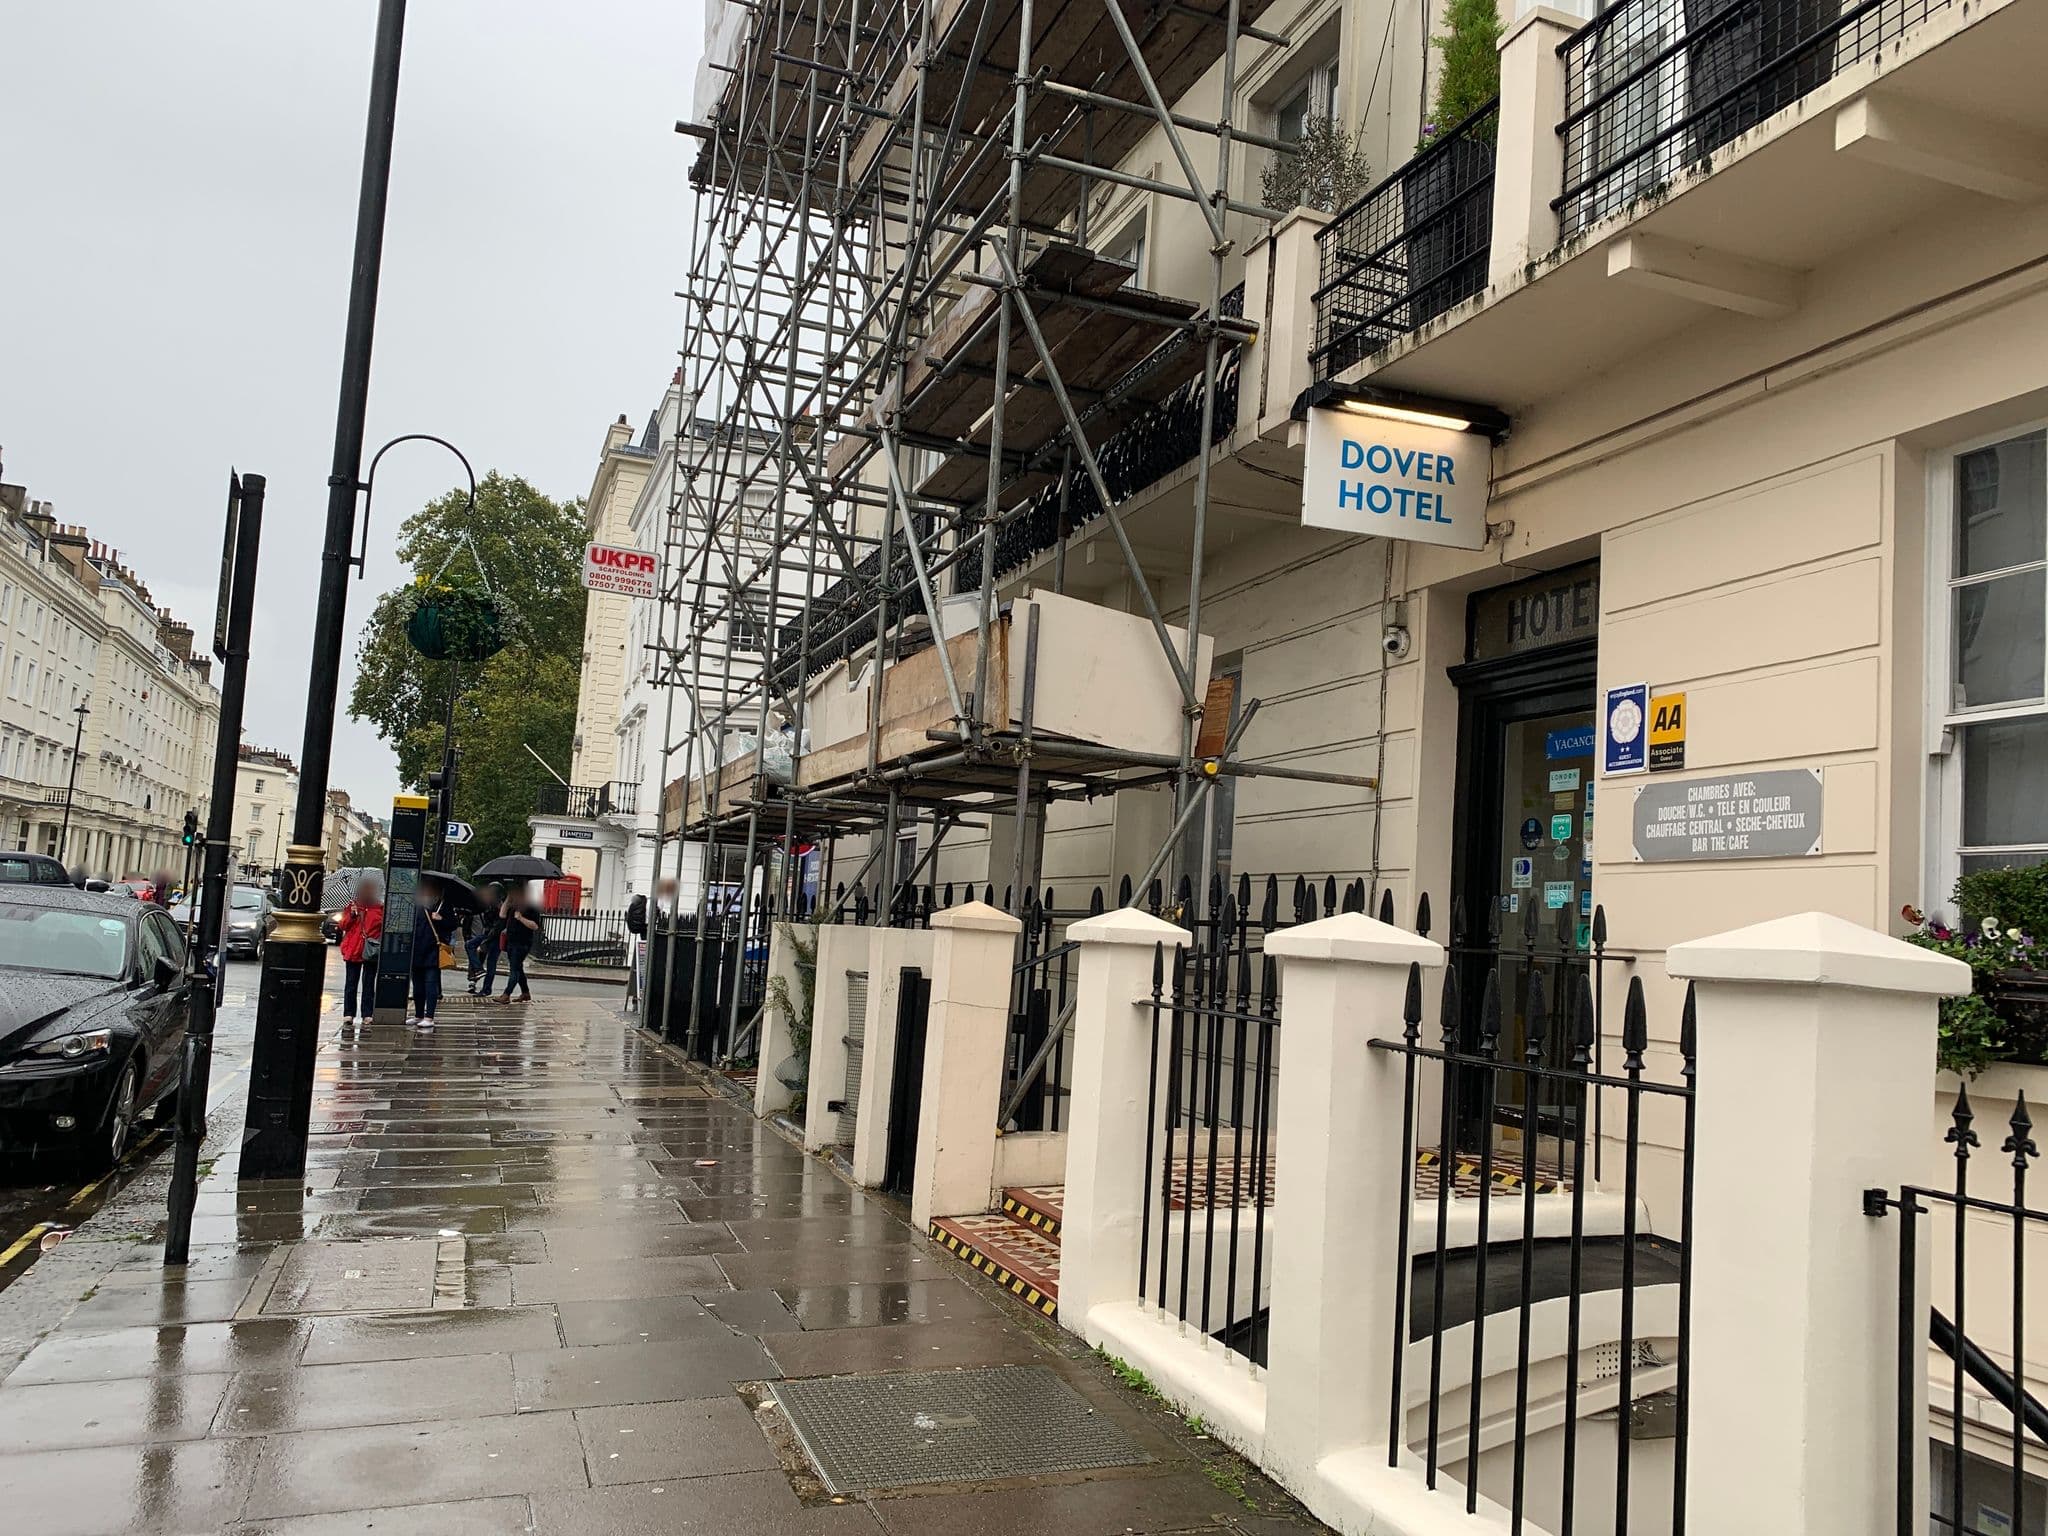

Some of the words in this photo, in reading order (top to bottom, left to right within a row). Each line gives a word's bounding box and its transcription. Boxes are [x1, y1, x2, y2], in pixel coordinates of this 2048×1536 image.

[1341, 439, 1455, 485] DOVER
[1338, 479, 1453, 524] HOTEL
[591, 547, 655, 574] UKPR
[589, 572, 612, 581] 0800
[598, 566, 645, 578] SCAFFOLDING
[588, 579, 615, 589] 07507
[618, 584, 634, 593] 570
[1653, 704, 1682, 732] AA
[1650, 746, 1683, 757] Associate
[1687, 783, 1730, 802] CHAMBRES
[1733, 781, 1756, 798] AVEC:
[1717, 800, 1736, 816] TELE
[1739, 799, 1750, 814] EN
[1753, 796, 1791, 814] COULEUR
[447, 824, 457, 835] P
[1646, 822, 1686, 839] CHAUFFAGE
[1689, 819, 1724, 836] CENTRAL
[1735, 812, 1805, 832] SECHE-CHEVEUX
[1692, 837, 1708, 852] BAR
